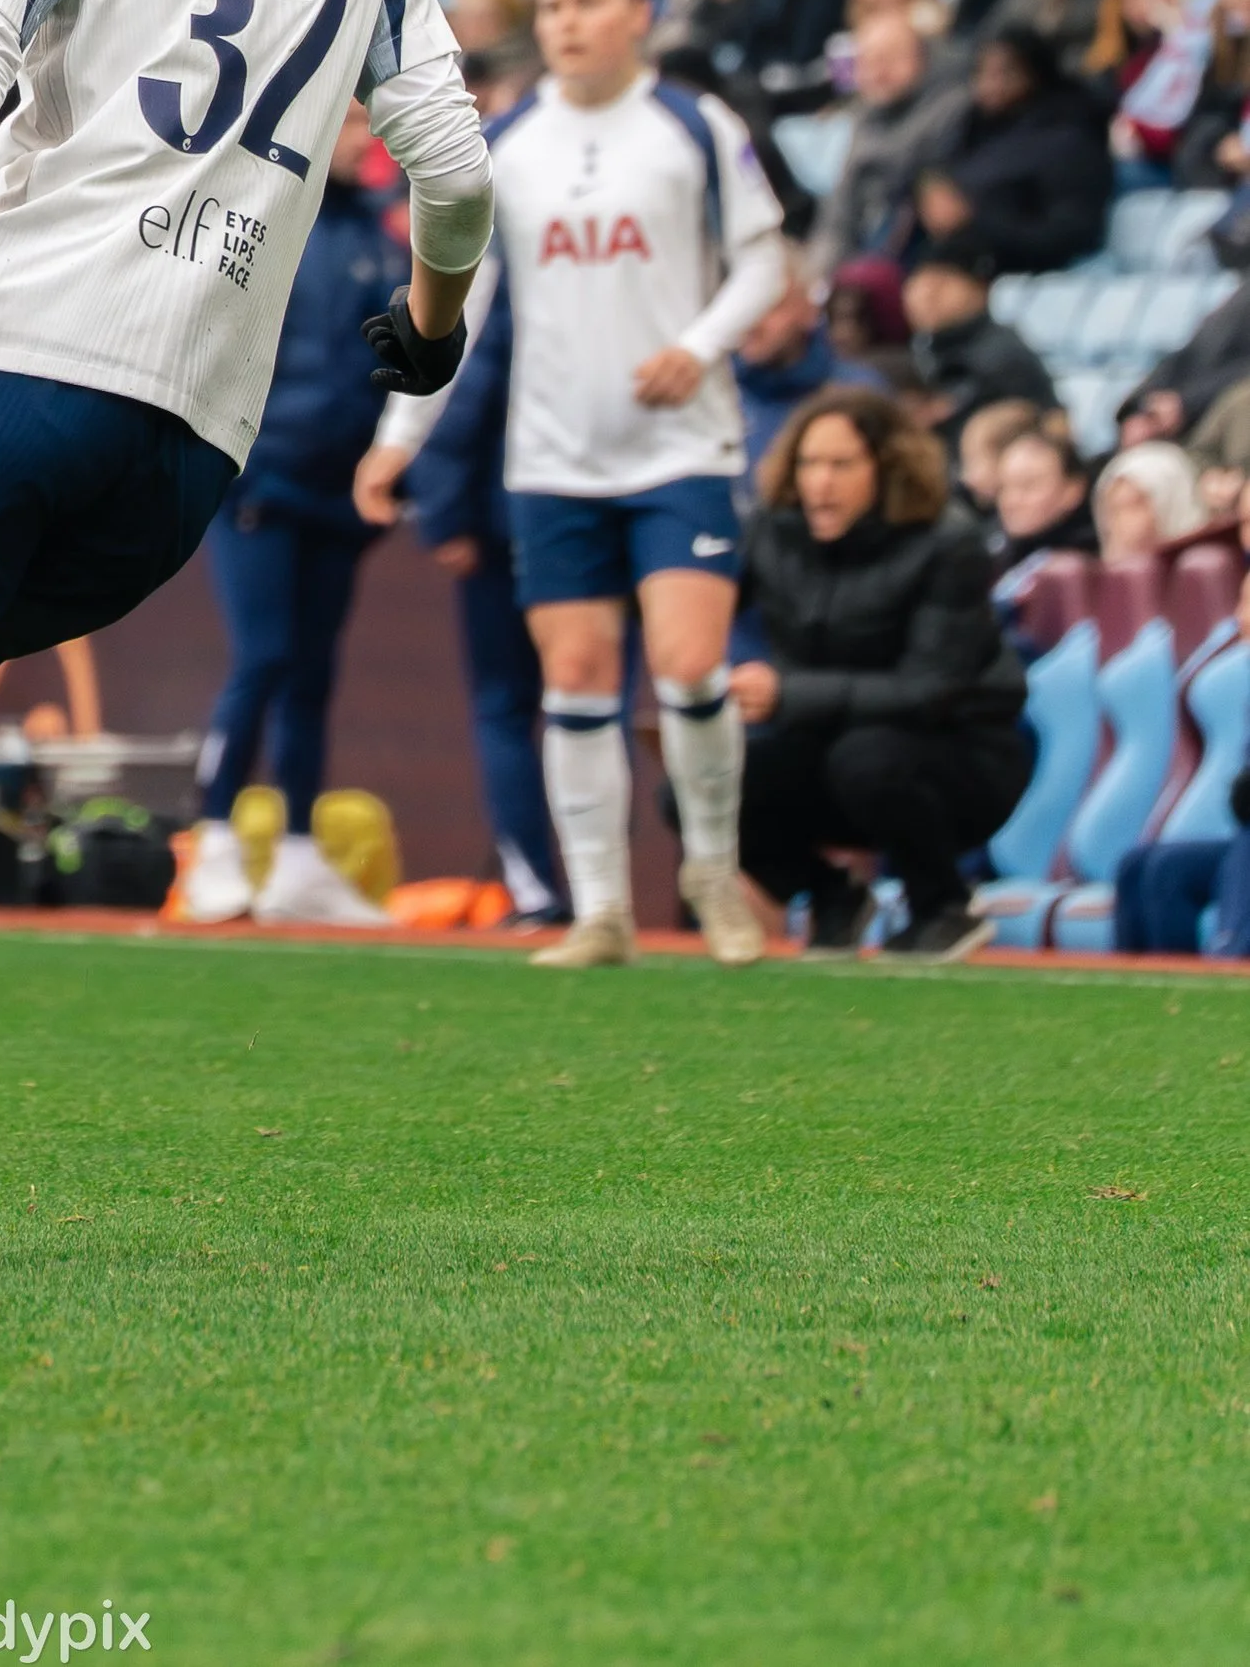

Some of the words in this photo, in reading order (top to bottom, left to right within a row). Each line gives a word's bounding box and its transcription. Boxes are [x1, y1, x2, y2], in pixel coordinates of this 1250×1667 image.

[225, 210, 268, 246] EYES.
[538, 215, 651, 266] AIA
[223, 232, 256, 267] LIPS.
[217, 254, 250, 292] FACE.
